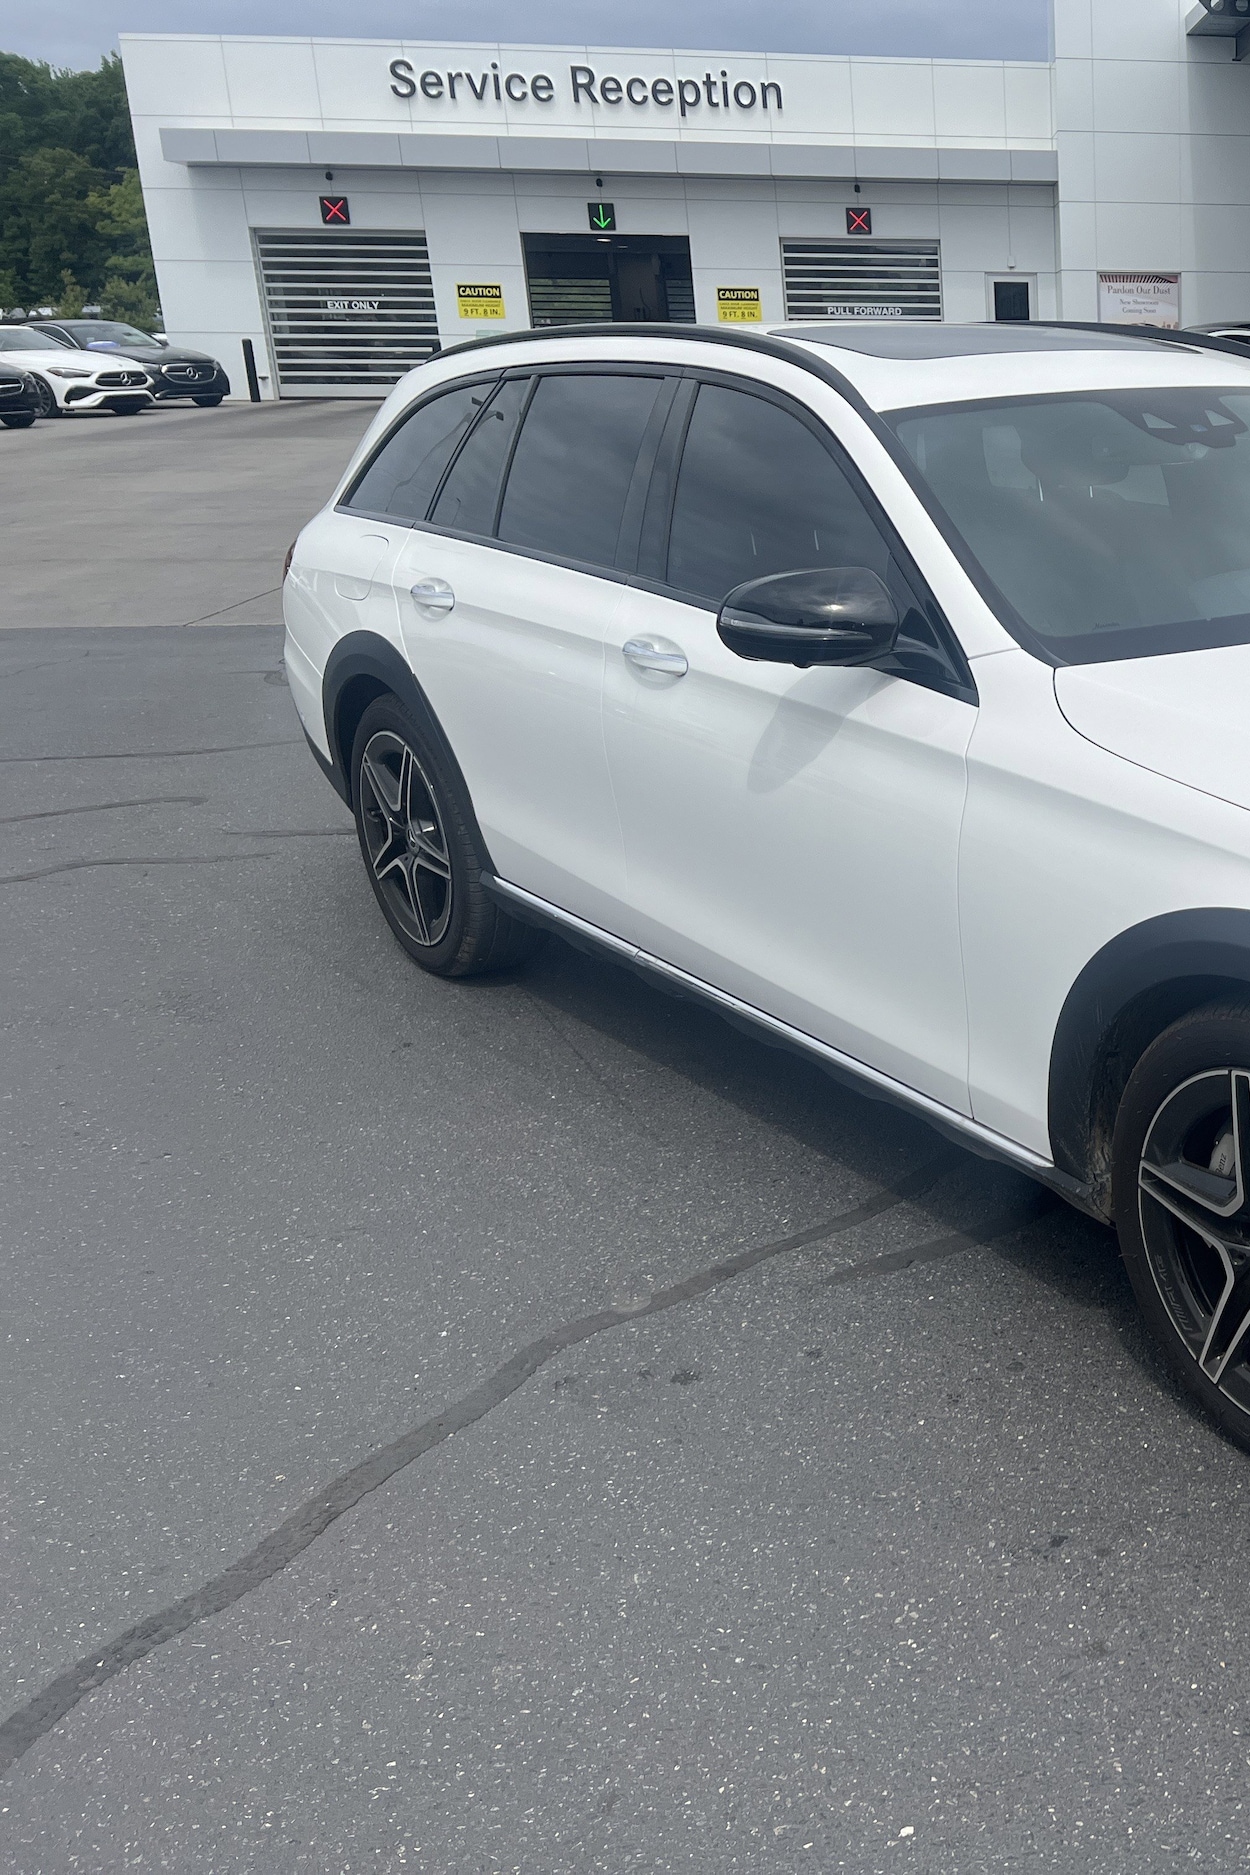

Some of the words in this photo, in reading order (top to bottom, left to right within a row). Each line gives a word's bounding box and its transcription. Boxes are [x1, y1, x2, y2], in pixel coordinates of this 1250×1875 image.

[389, 58, 554, 103] Service
[569, 65, 783, 117] Reception
[459, 287, 500, 297] CAUTION
[719, 290, 758, 299] CAUTION
[1107, 285, 1134, 294] Pardon
[1136, 285, 1151, 294] Our
[1153, 285, 1171, 295] Dust
[327, 301, 350, 309] EXIT
[351, 301, 379, 310] ONLY
[828, 307, 852, 315] PULL
[854, 307, 902, 316] FORWARD
